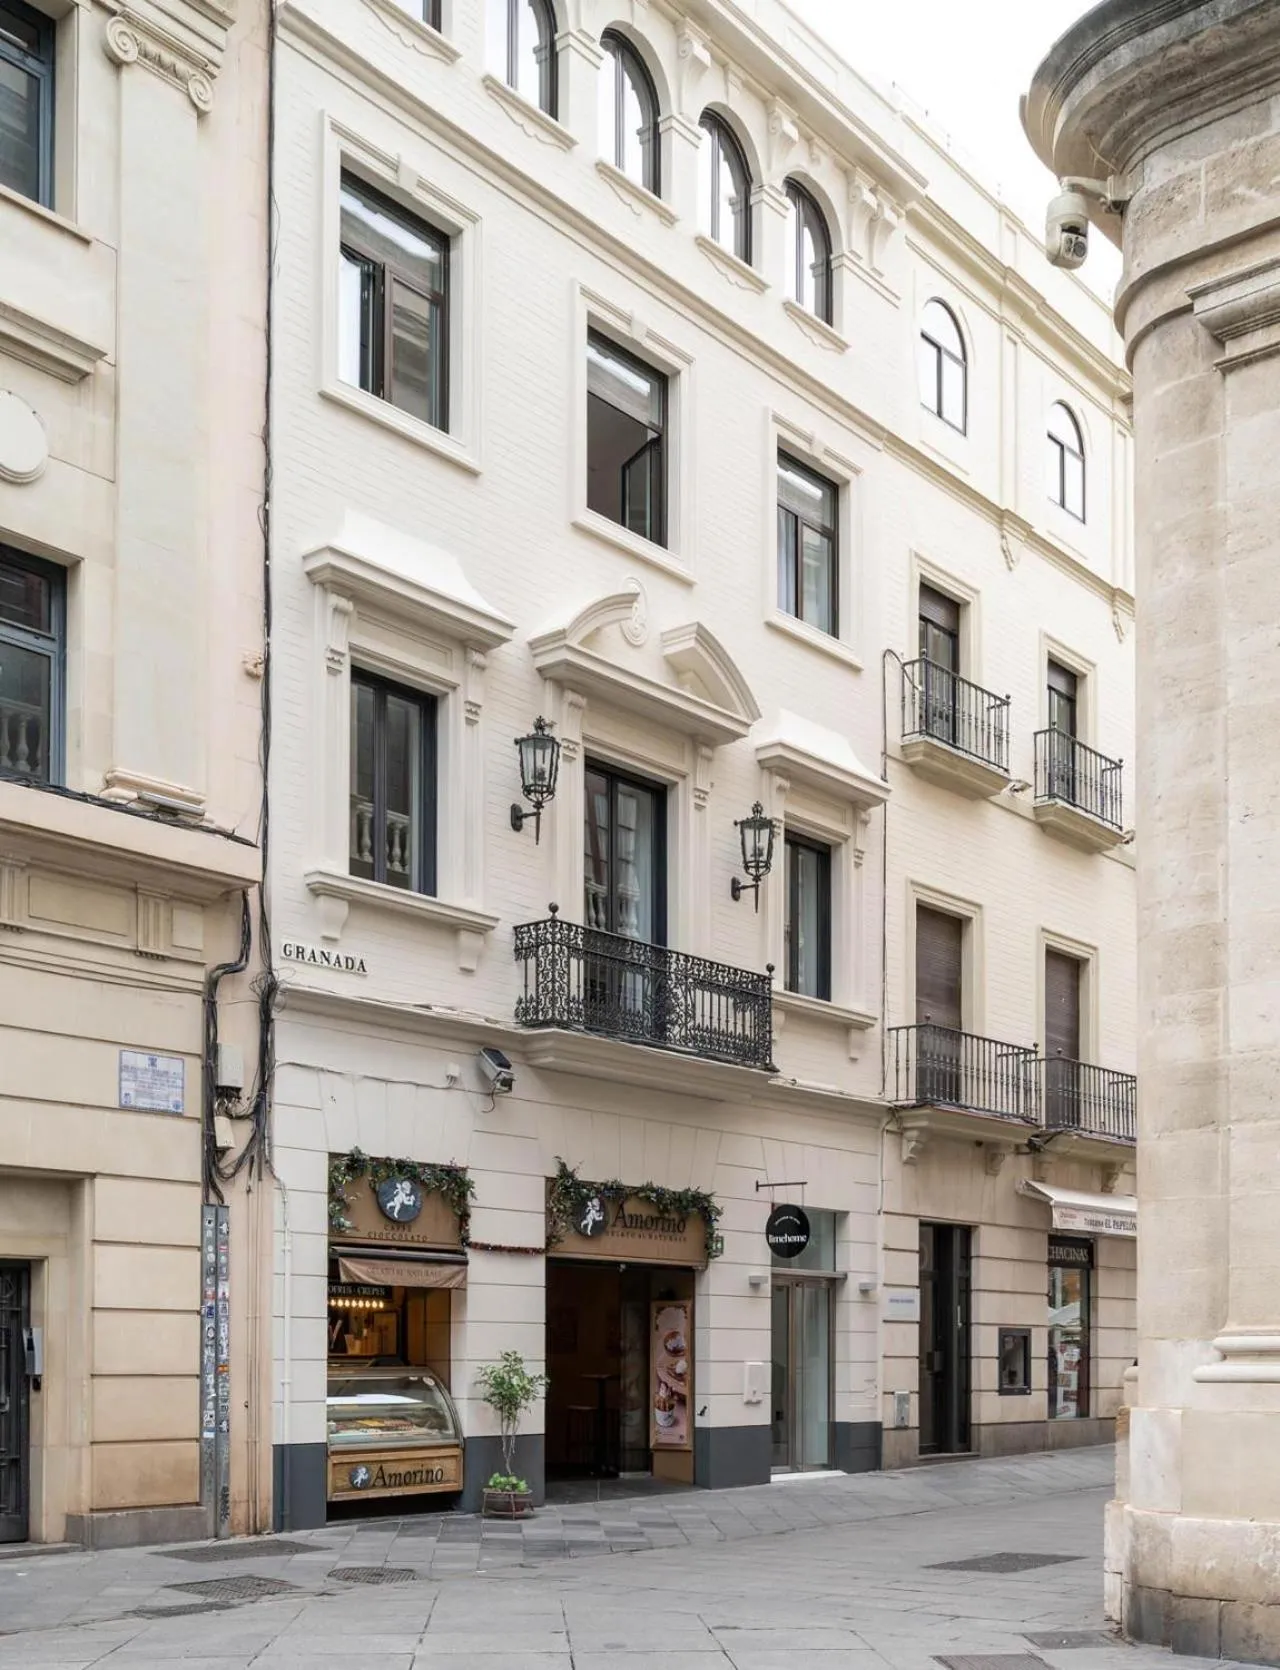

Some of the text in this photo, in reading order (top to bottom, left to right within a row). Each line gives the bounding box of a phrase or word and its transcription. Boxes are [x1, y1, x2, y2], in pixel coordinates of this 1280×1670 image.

[283, 943, 367, 972] GRANADA
[610, 1199, 686, 1233] Amorino
[1104, 1218, 1112, 1228] EL
[367, 1231, 428, 1242] CIOCCOLATO
[372, 1463, 444, 1487] Amorino
